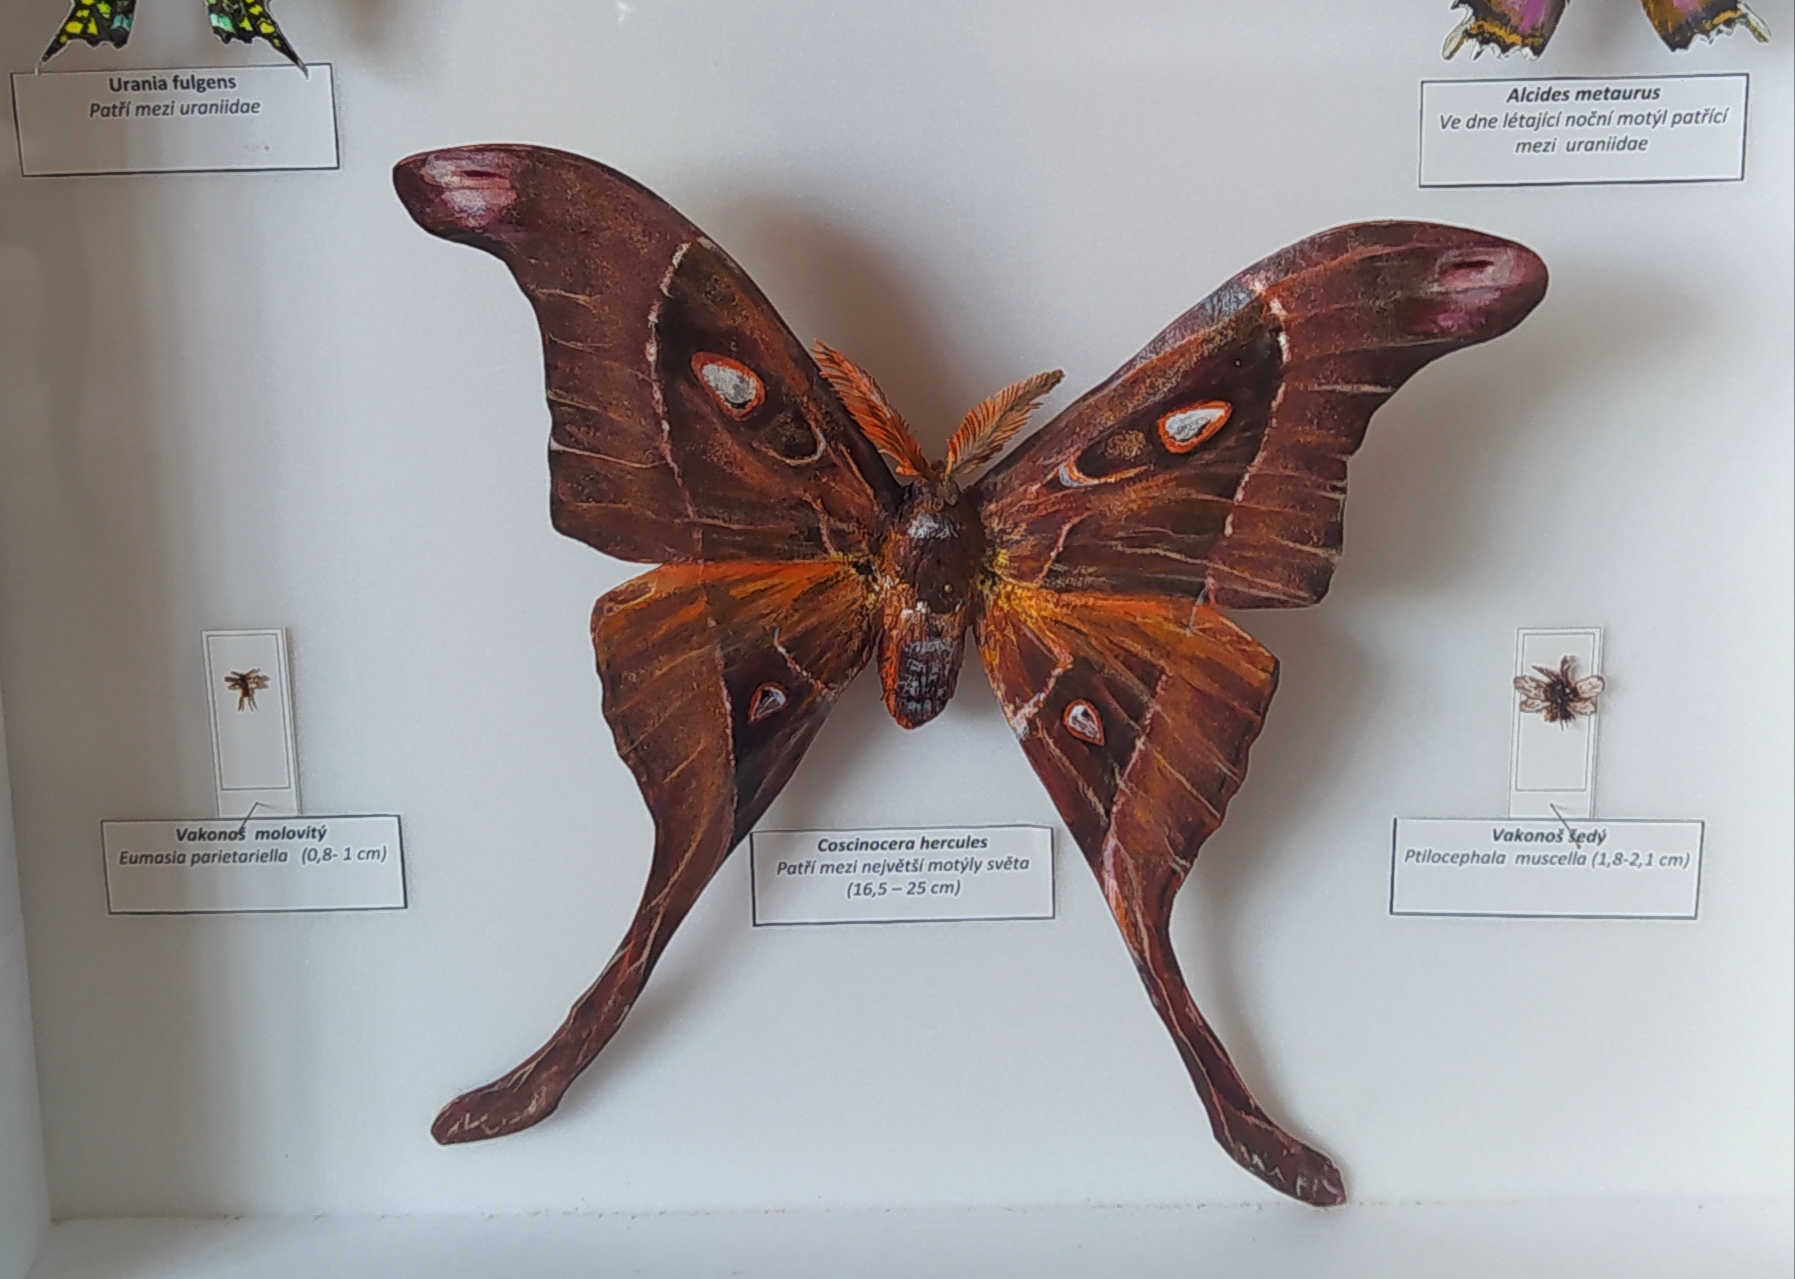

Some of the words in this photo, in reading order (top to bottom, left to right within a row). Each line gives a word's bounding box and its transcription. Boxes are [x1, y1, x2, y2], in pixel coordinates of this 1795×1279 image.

[109, 77, 167, 92] Urania
[172, 74, 236, 92] fulgens
[1507, 87, 1569, 103] Alcides
[1575, 87, 1660, 101] metaurus
[90, 101, 130, 118] Patří
[136, 101, 175, 117] mezi
[180, 100, 260, 115] uraniidae
[1440, 115, 1461, 129] Ve
[1466, 114, 1498, 129] dne
[1503, 111, 1561, 130] létající
[1565, 111, 1614, 127] noční
[1617, 109, 1666, 128] motýl
[1671, 107, 1729, 128] patřící
[1516, 138, 1558, 153] mezi
[1566, 137, 1648, 152] uraniidae
[177, 826, 246, 842] Vakonoš
[255, 825, 327, 841] molovitý
[1493, 828, 1564, 843] Vakonoš
[1568, 829, 1606, 845] šedý
[818, 838, 915, 852] Coscinocera
[920, 836, 988, 850] hercules
[120, 850, 186, 865] Eumasia
[190, 849, 288, 866] parietariella
[358, 846, 387, 863] cm)
[1405, 849, 1506, 866] Ptilocephala
[1515, 850, 1586, 866] muscella
[1591, 851, 1653, 869] (1,8-2,1
[1659, 852, 1689, 869] cm)
[777, 860, 816, 875] Patří
[820, 860, 858, 874] mezi
[862, 858, 924, 876] největší
[928, 858, 983, 874] motýly
[987, 857, 1029, 871] světa
[846, 881, 887, 899] (16,5
[907, 881, 926, 894] 25
[931, 880, 961, 897] cm)
